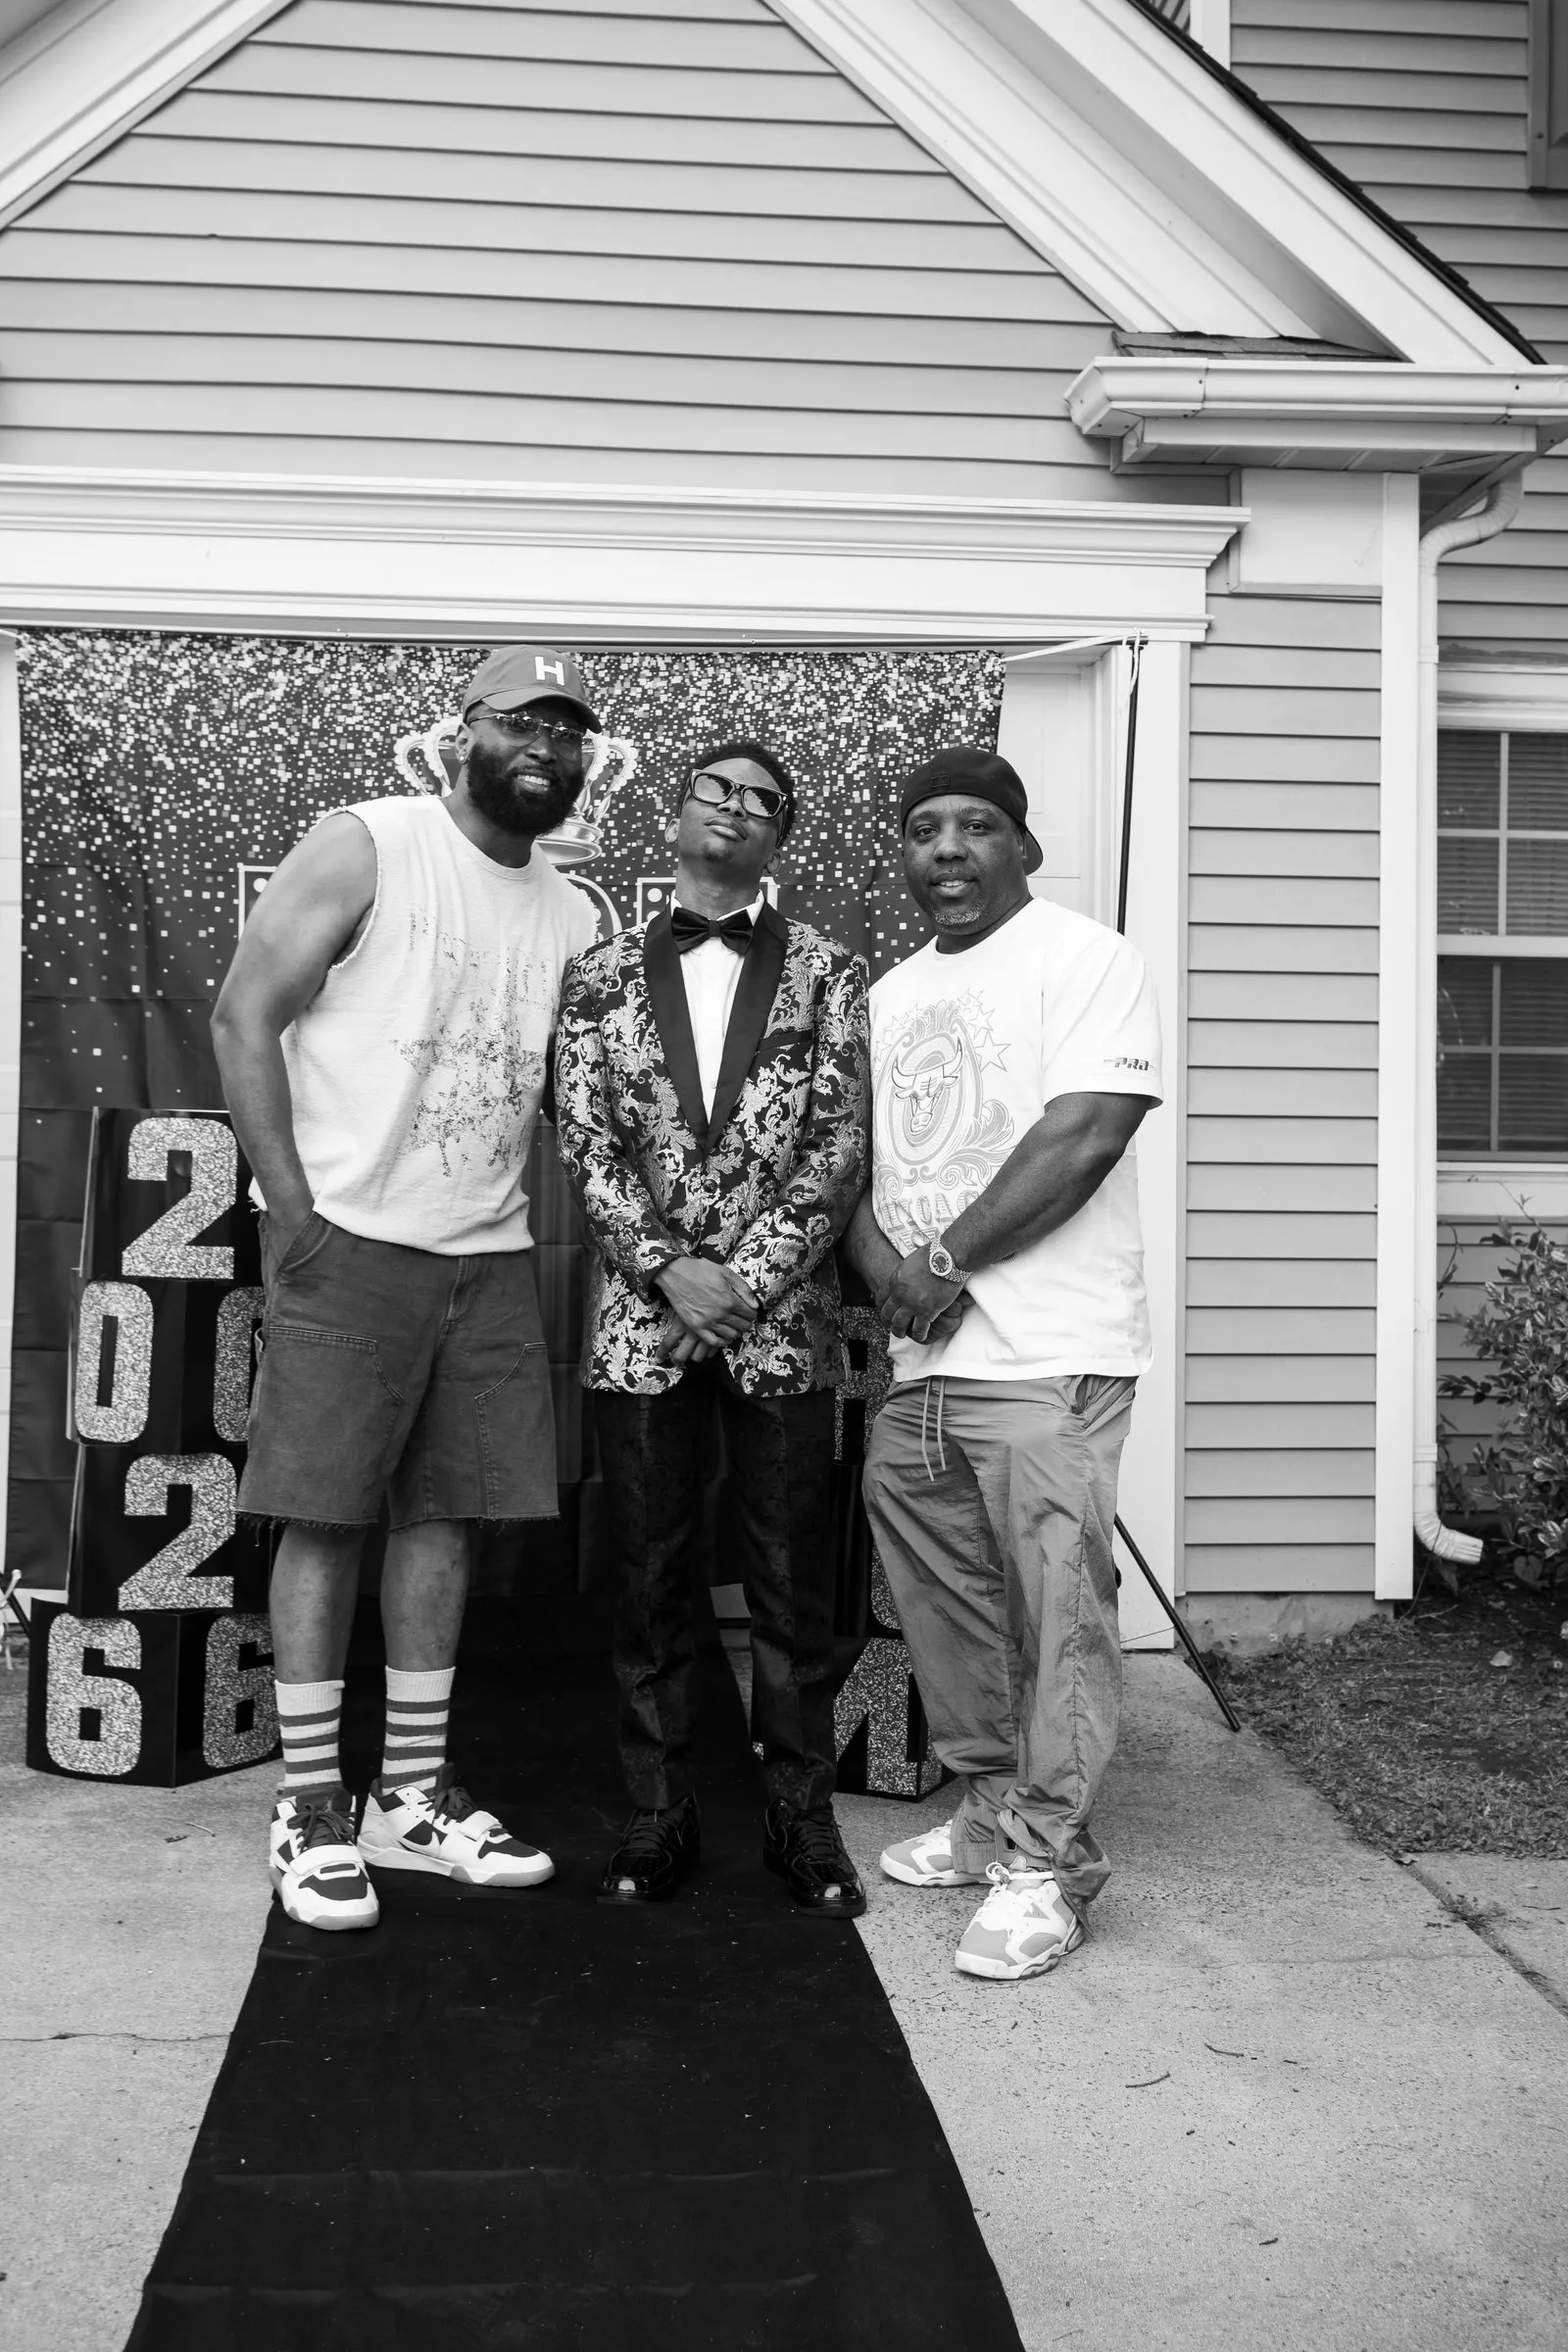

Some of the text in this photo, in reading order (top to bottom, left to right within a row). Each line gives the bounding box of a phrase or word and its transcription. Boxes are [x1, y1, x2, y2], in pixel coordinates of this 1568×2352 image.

[535, 657, 564, 686] H
[122, 1117, 238, 1279] 2
[74, 1281, 153, 1443] 0
[119, 1452, 236, 1610] 2
[46, 1612, 142, 1776] 6
